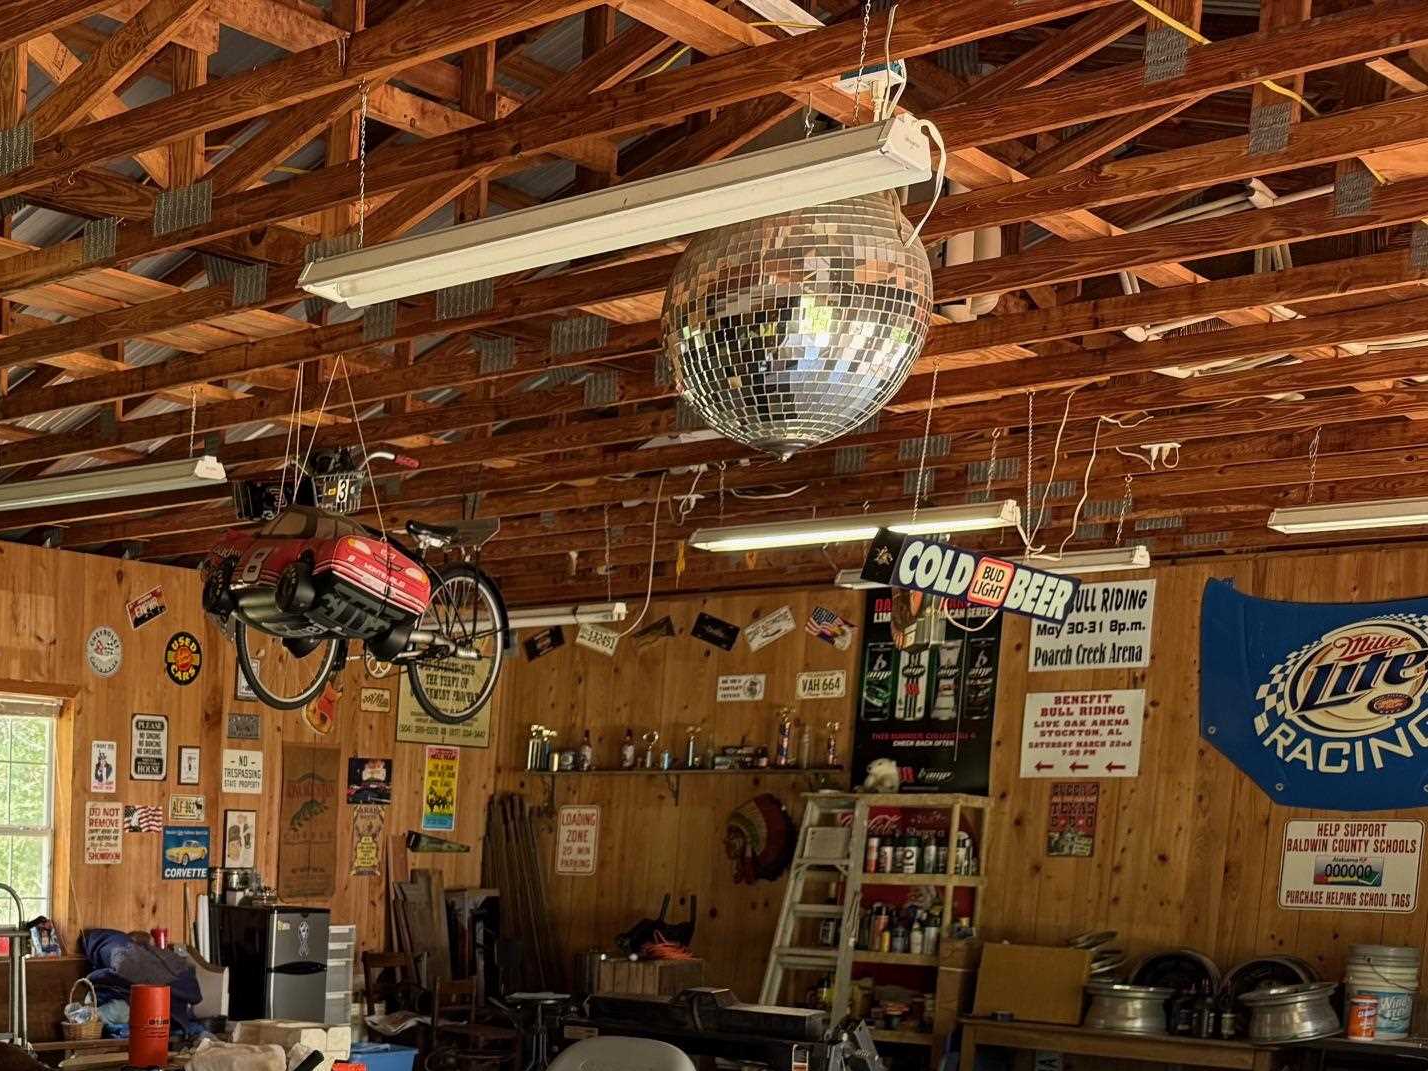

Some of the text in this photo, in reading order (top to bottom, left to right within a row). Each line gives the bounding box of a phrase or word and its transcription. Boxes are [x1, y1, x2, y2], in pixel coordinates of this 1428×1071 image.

[337, 478, 348, 502] 3
[899, 540, 975, 596] COLD
[982, 565, 1005, 583] BUD
[972, 581, 1005, 600] LIGHT
[1004, 567, 1074, 621] BEER
[1069, 587, 1148, 614] ULL RIDING
[1036, 620, 1146, 639] May 30-31 8p.m.
[171, 635, 198, 651] USED
[1333, 634, 1412, 660] Miller
[1034, 641, 1143, 667] Poarch Creek Arena
[170, 664, 196, 681] CARS
[801, 678, 840, 693] VAH 664
[1292, 648, 1428, 713] Lite
[1054, 694, 1113, 705] BENEFIT
[1040, 705, 1125, 717] BULL RIDING
[137, 720, 162, 730] PLEASE
[1034, 718, 1129, 728] LIVE OAK ARENA
[1039, 728, 1123, 737] STOCKTON, AL
[1028, 741, 1073, 749] SATURDAY
[1076, 740, 1107, 748] MARCH
[238, 755, 248, 767] NO
[137, 766, 160, 775] HOUSE
[224, 767, 262, 779] TRESPASSING
[238, 780, 260, 789] PROPERTY
[89, 807, 120, 817] DO NOT
[1051, 802, 1096, 815] TEXAS
[89, 818, 119, 828] REMOVE
[561, 813, 596, 826] LOADING
[565, 830, 589, 843] ZONE
[1317, 823, 1387, 838] HELP SUPPORT
[1286, 838, 1417, 854] BALDWIN COUNTY SCHOOLS
[88, 851, 121, 860] SHOWROOM
[164, 868, 208, 878] CORVETTE
[1324, 863, 1372, 879] 000000
[1285, 890, 1411, 908] PURCHASE HELPING SCHOOL TAGS
